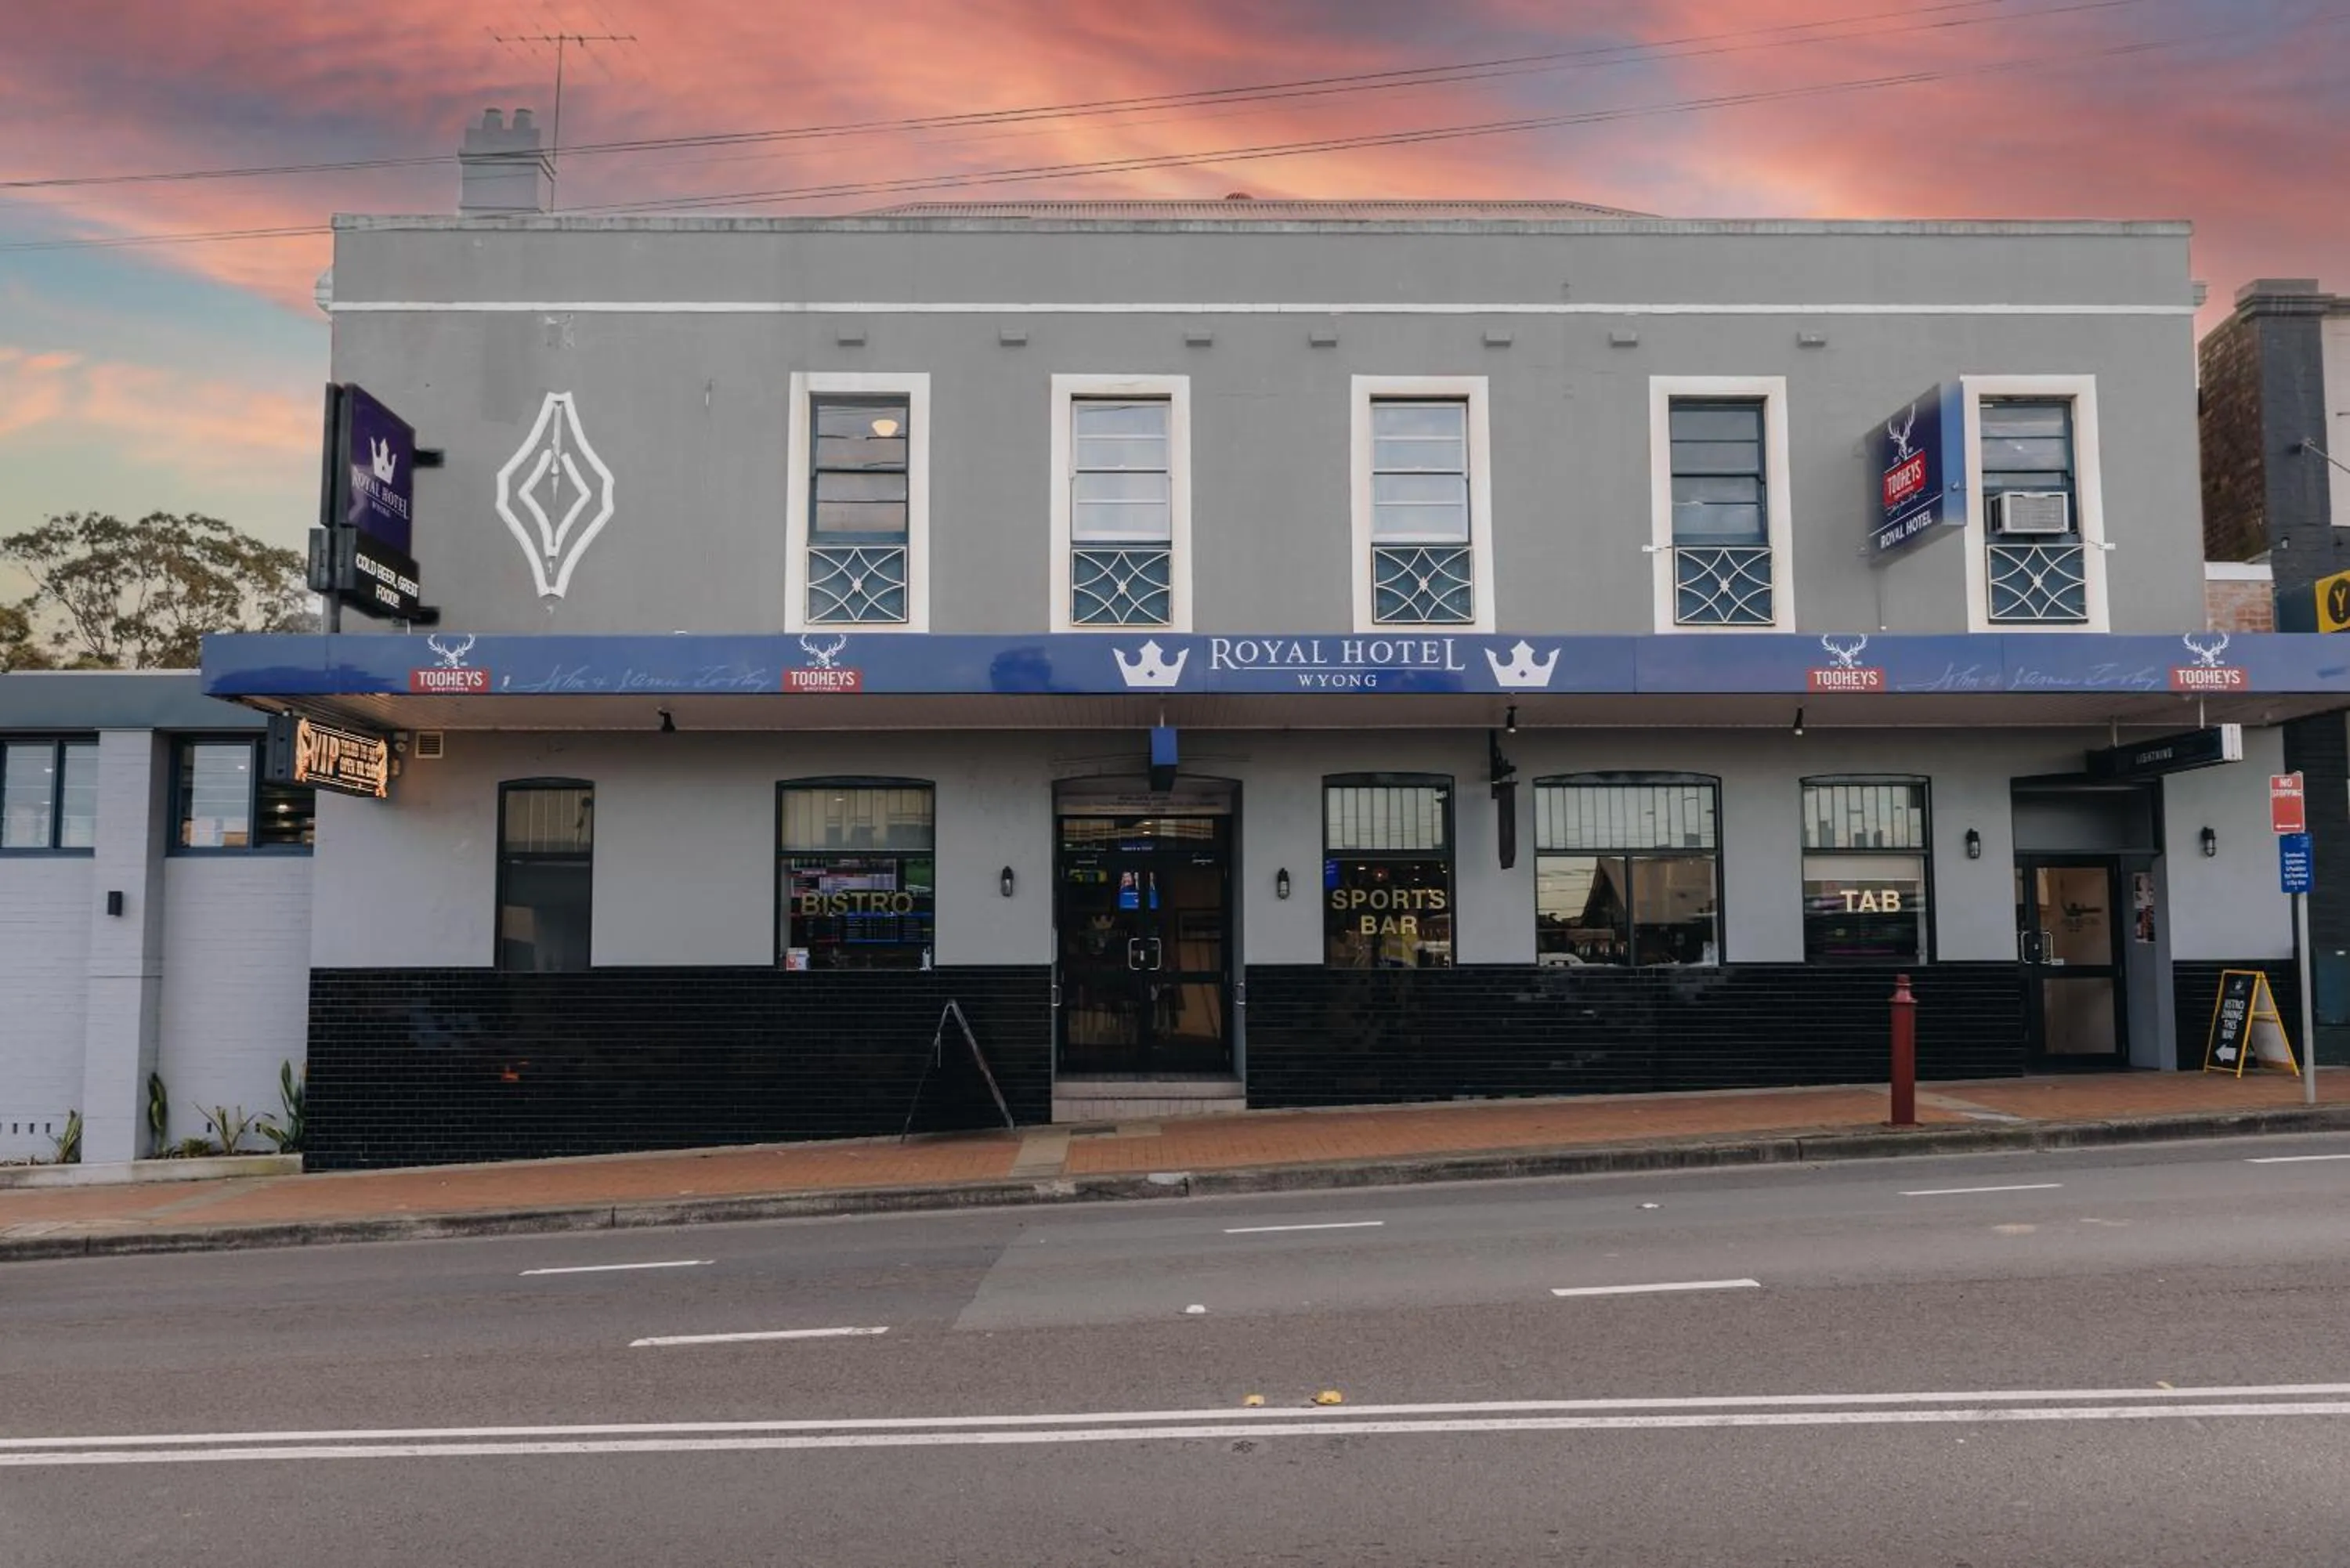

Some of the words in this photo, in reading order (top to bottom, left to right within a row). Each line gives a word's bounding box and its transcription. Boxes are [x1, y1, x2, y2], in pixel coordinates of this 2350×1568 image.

[1886, 459, 1922, 497] TOOHEYS
[352, 464, 381, 497] ROYAL
[381, 486, 410, 519] HOTEL
[1881, 524, 1905, 548] ROYAL
[1906, 510, 1932, 535] HOTEL
[356, 552, 377, 576] COLD
[1210, 638, 1328, 670] ROYAL
[1340, 638, 1466, 670] HOTEL
[418, 671, 483, 687] TOOHEYS
[790, 671, 855, 686] TOOHEYS
[1298, 674, 1377, 687] WYONG
[1813, 670, 1878, 686] TOOHEYS
[2175, 670, 2241, 684] TOOHEYS
[309, 730, 340, 775] VIP
[2280, 778, 2293, 788] NO
[801, 891, 913, 916] BISTRO
[1332, 889, 1446, 909] SPORTS
[1841, 890, 1901, 912] TAB
[1361, 916, 1417, 934] BAR
